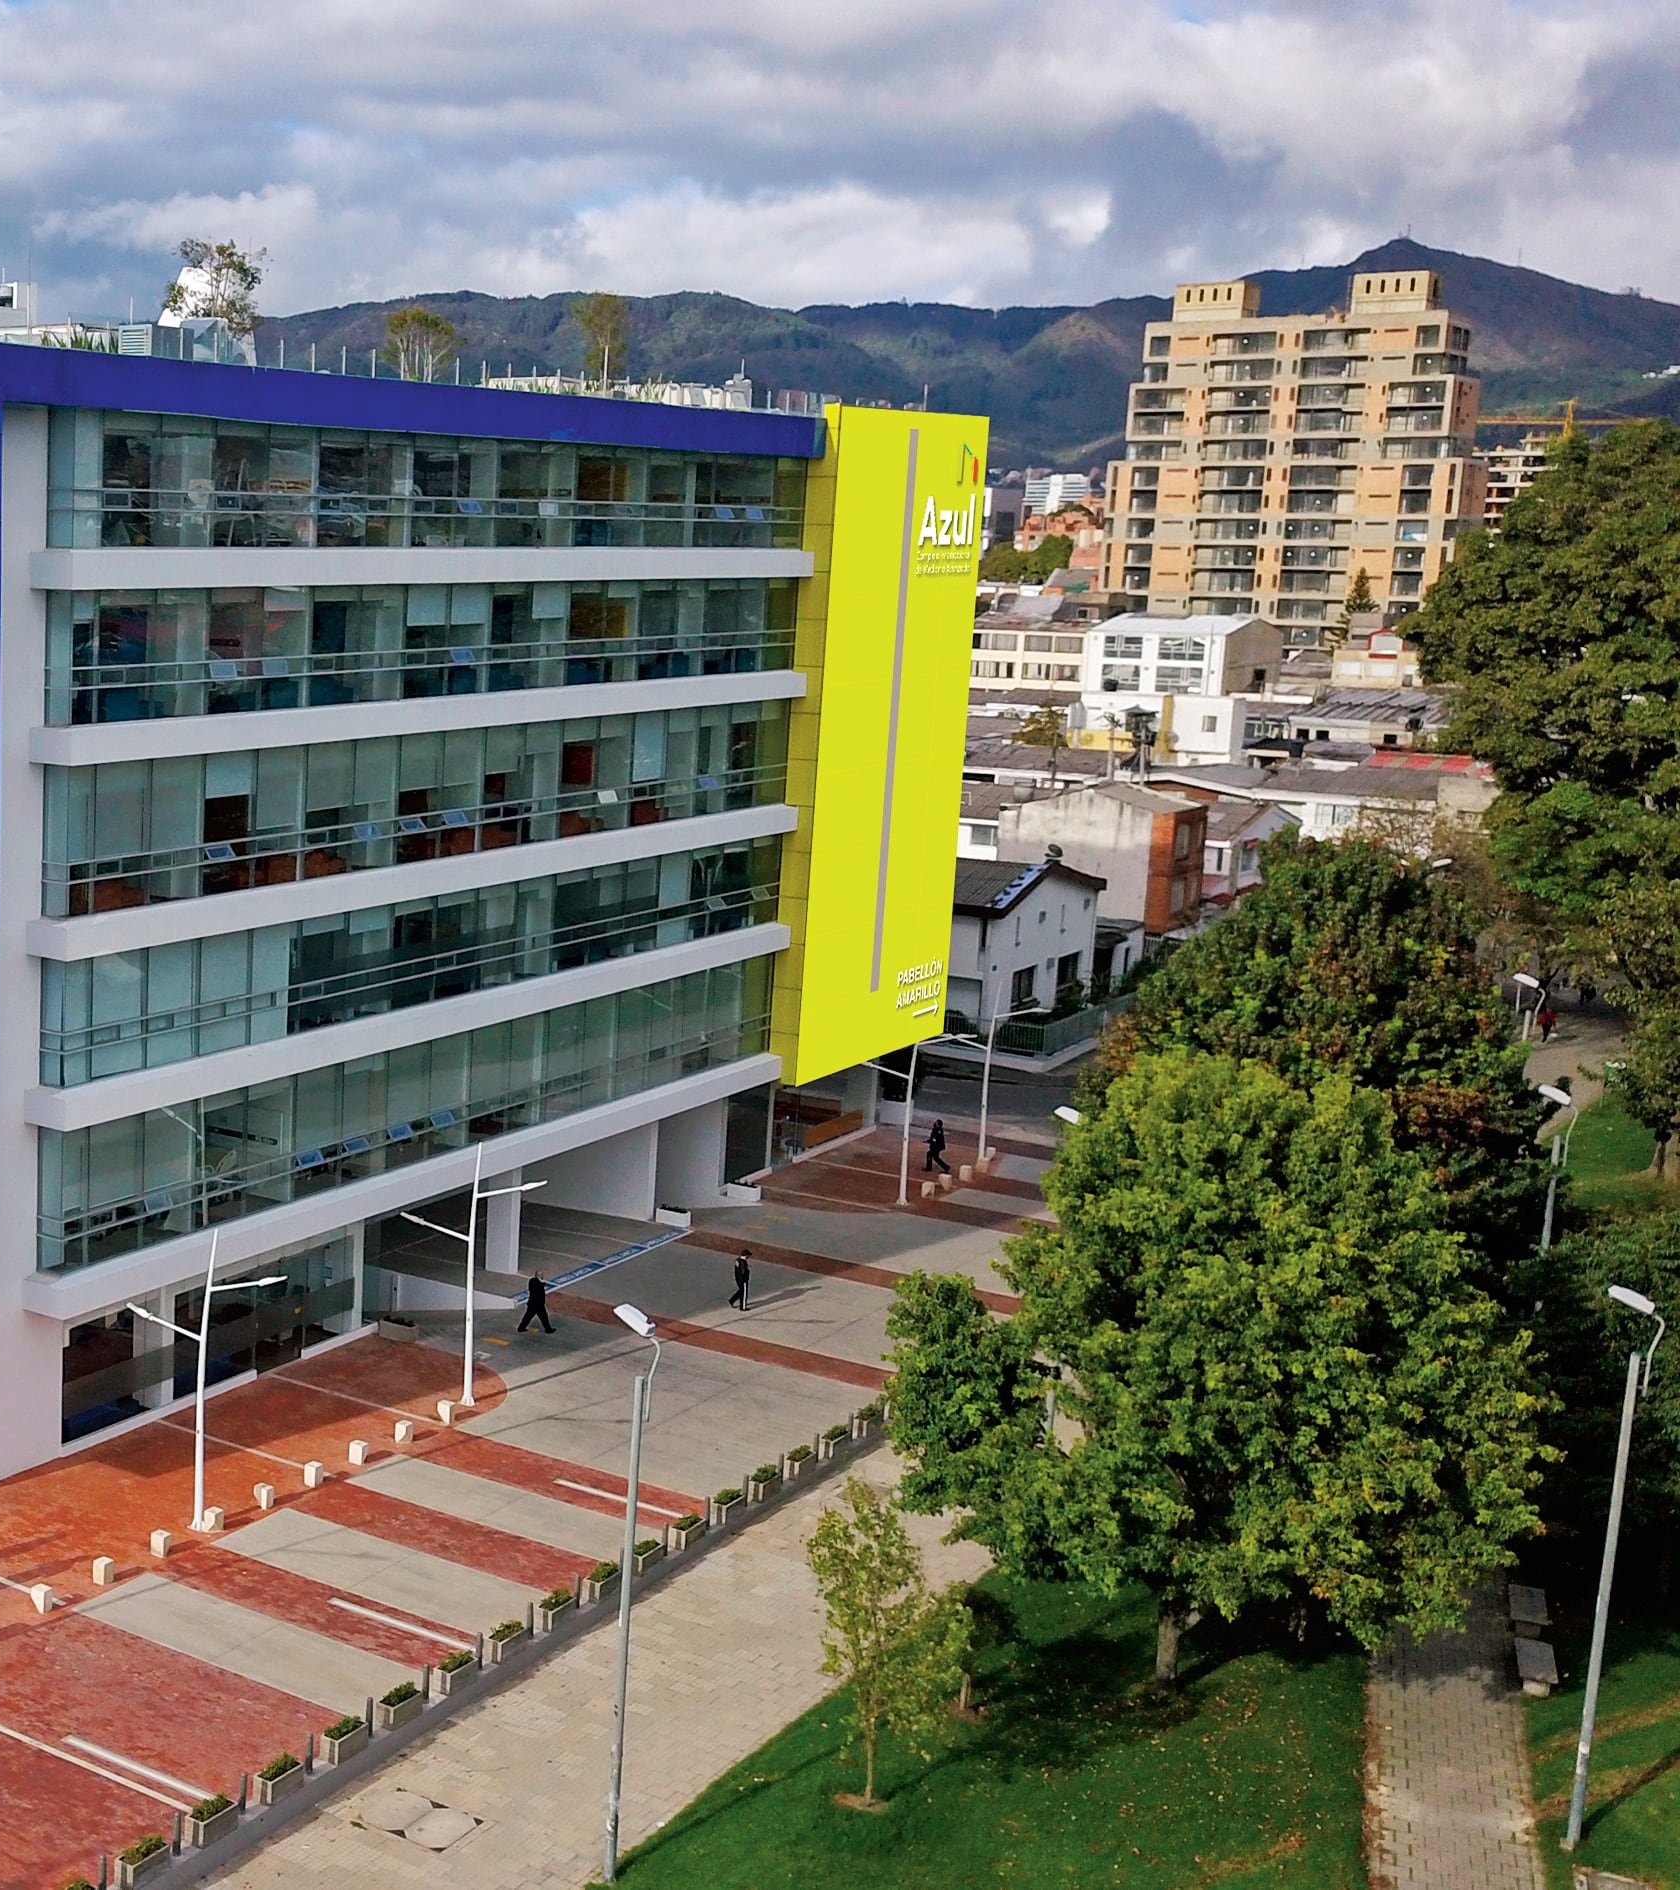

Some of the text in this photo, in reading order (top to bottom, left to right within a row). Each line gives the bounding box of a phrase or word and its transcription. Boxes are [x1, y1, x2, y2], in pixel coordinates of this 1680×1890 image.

[917, 493, 976, 546] Azul
[897, 957, 943, 988] PABELLÓN
[895, 980, 941, 1010] AMARILLO
